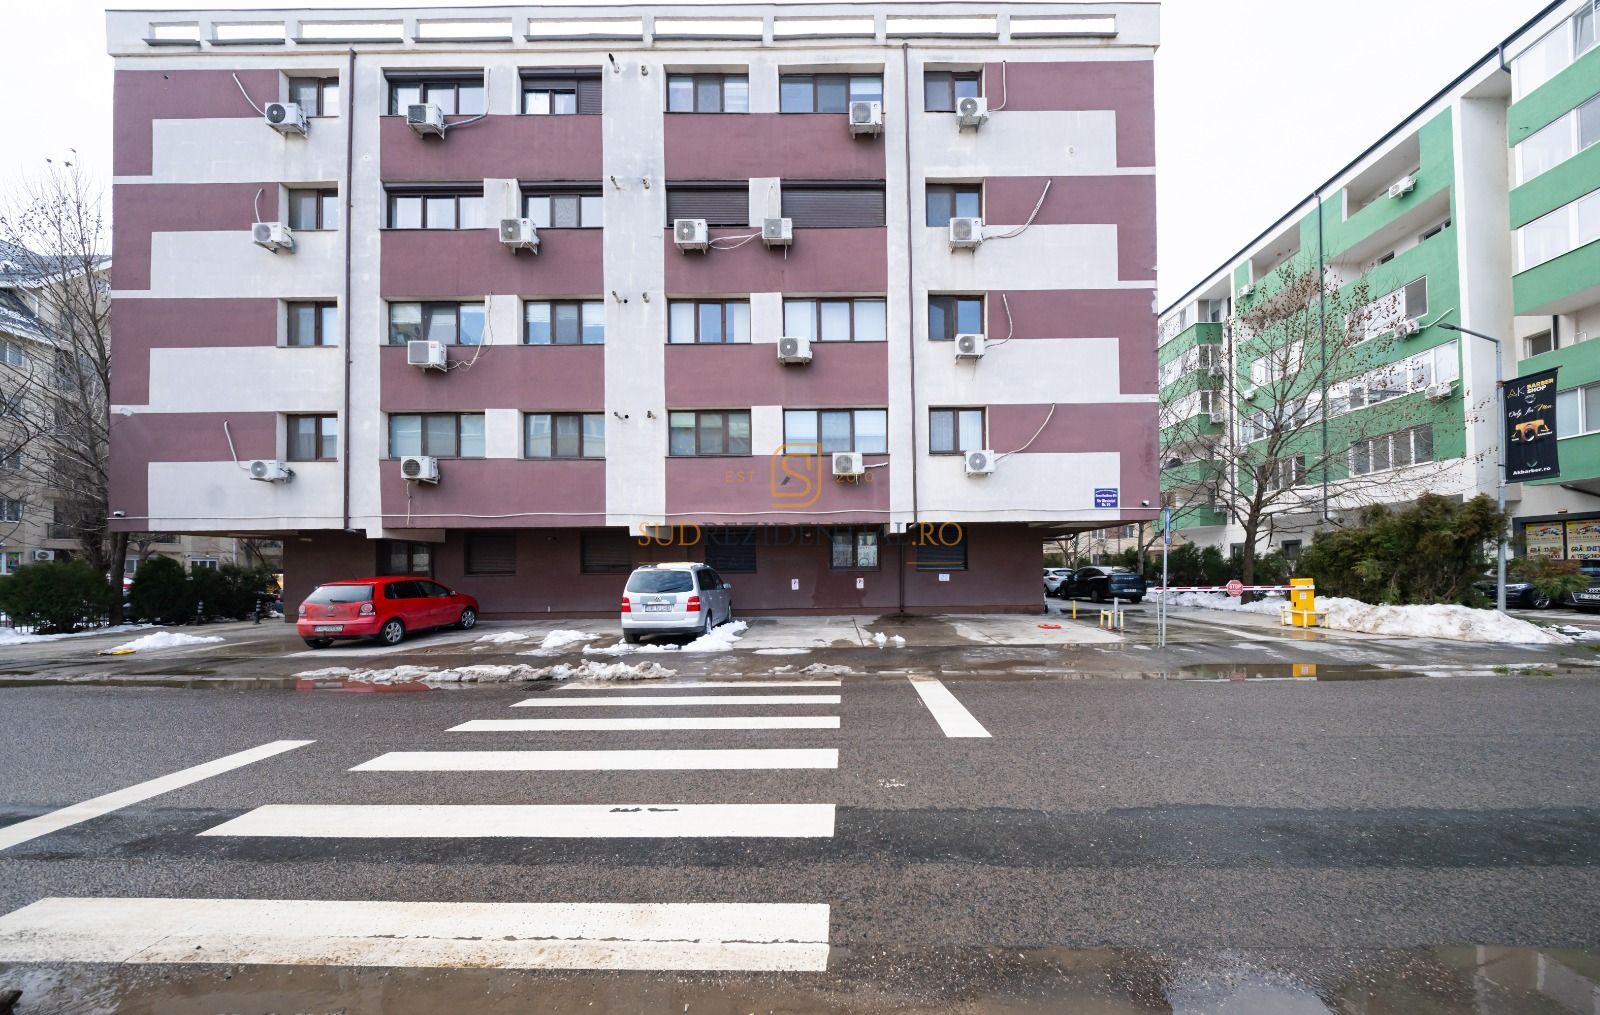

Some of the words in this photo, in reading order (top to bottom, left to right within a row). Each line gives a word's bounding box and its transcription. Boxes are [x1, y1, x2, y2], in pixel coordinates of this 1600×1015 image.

[1526, 378, 1553, 388] BARBER
[1526, 385, 1547, 394] SHOP
[1508, 409, 1522, 419] Only
[1512, 466, 1551, 476] Akbarber.ro
